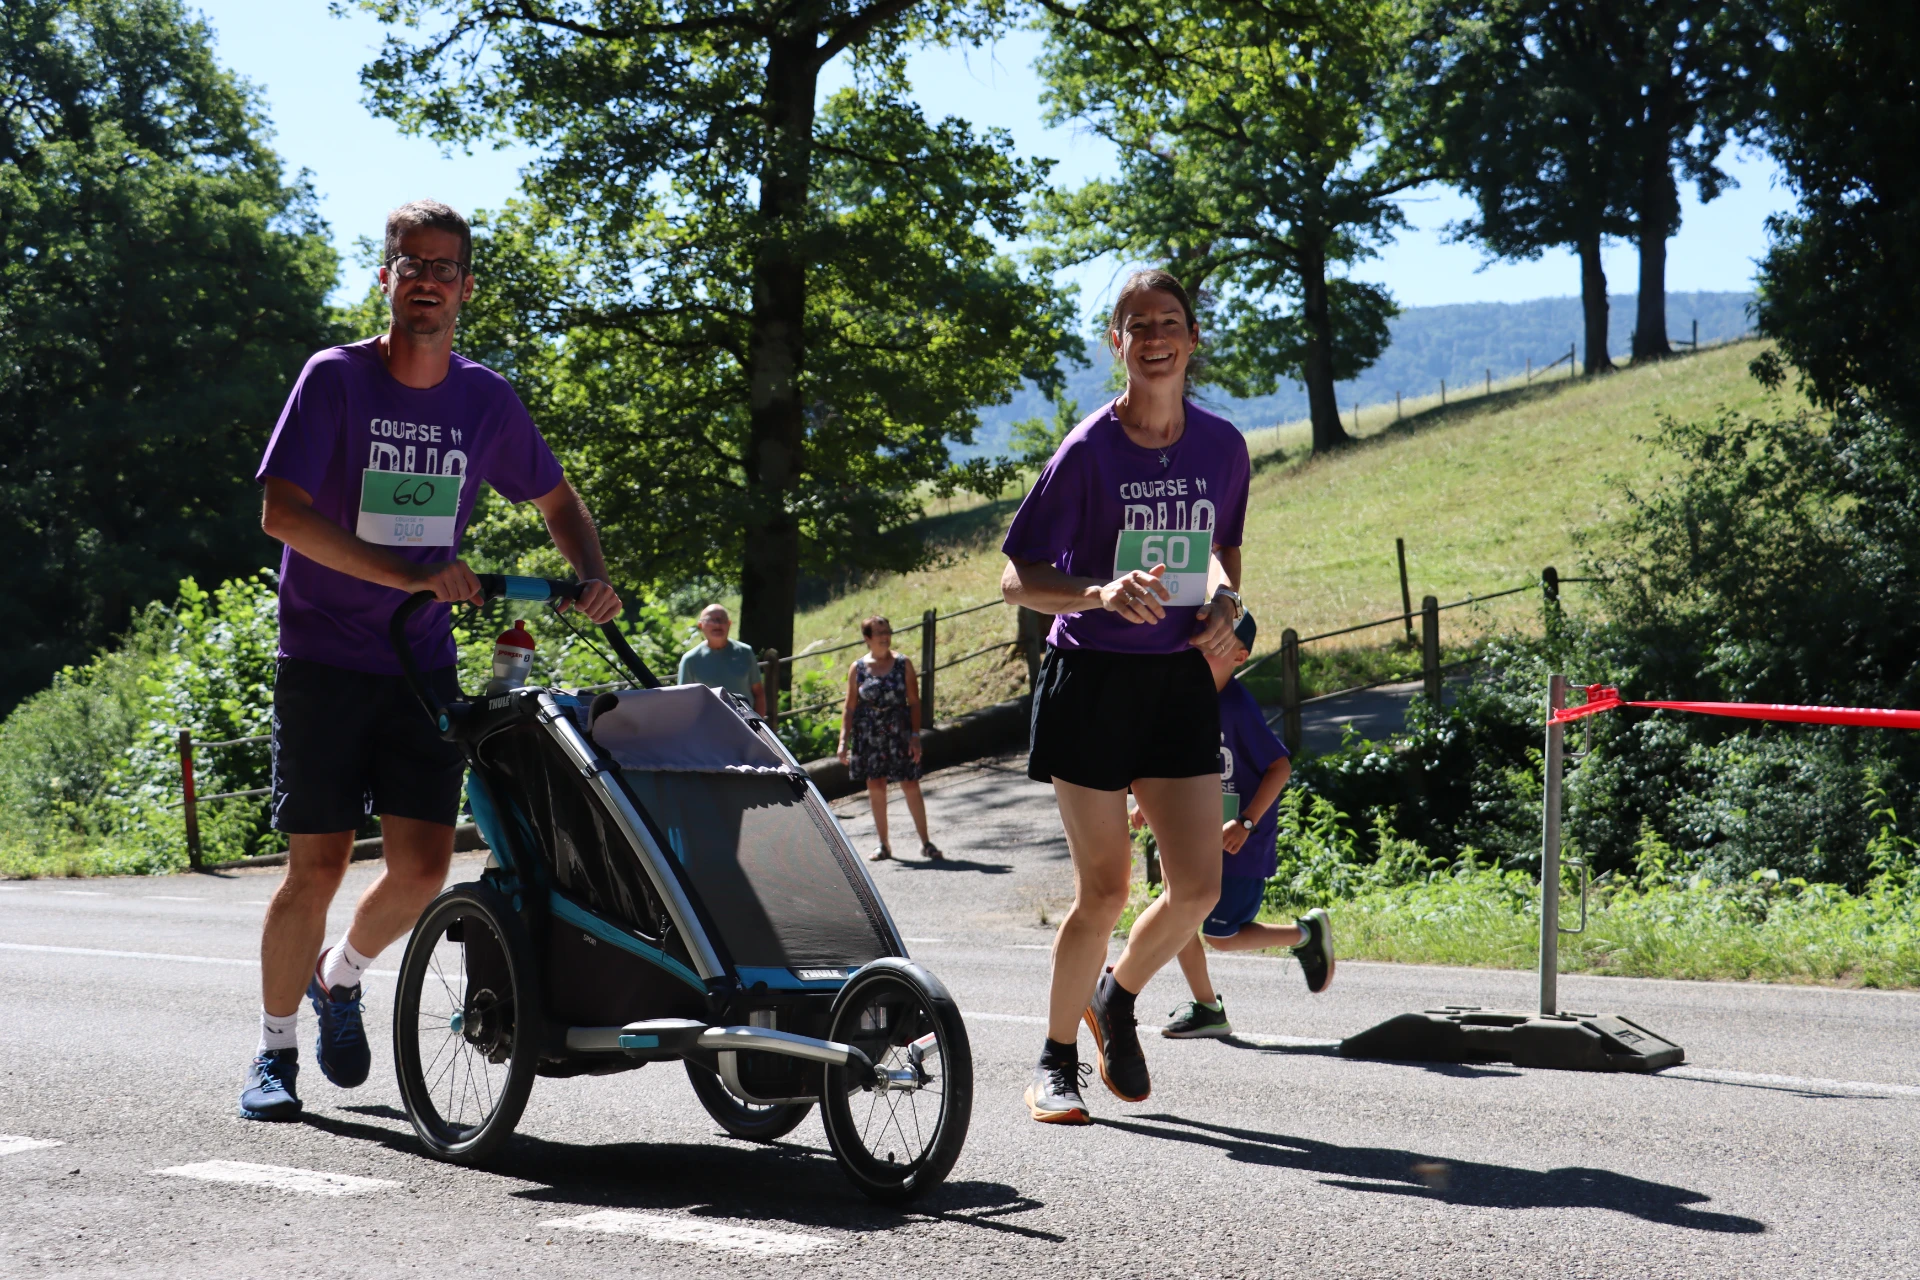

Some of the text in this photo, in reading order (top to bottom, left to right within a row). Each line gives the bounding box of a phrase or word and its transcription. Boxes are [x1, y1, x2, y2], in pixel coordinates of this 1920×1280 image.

[370, 418, 442, 443] COURSE
[393, 478, 435, 506] 60
[1119, 478, 1188, 500] COURSE
[394, 523, 425, 537] DUO
[1141, 535, 1190, 569] 60
[488, 695, 511, 711] THULE
[798, 969, 843, 978] THULE
